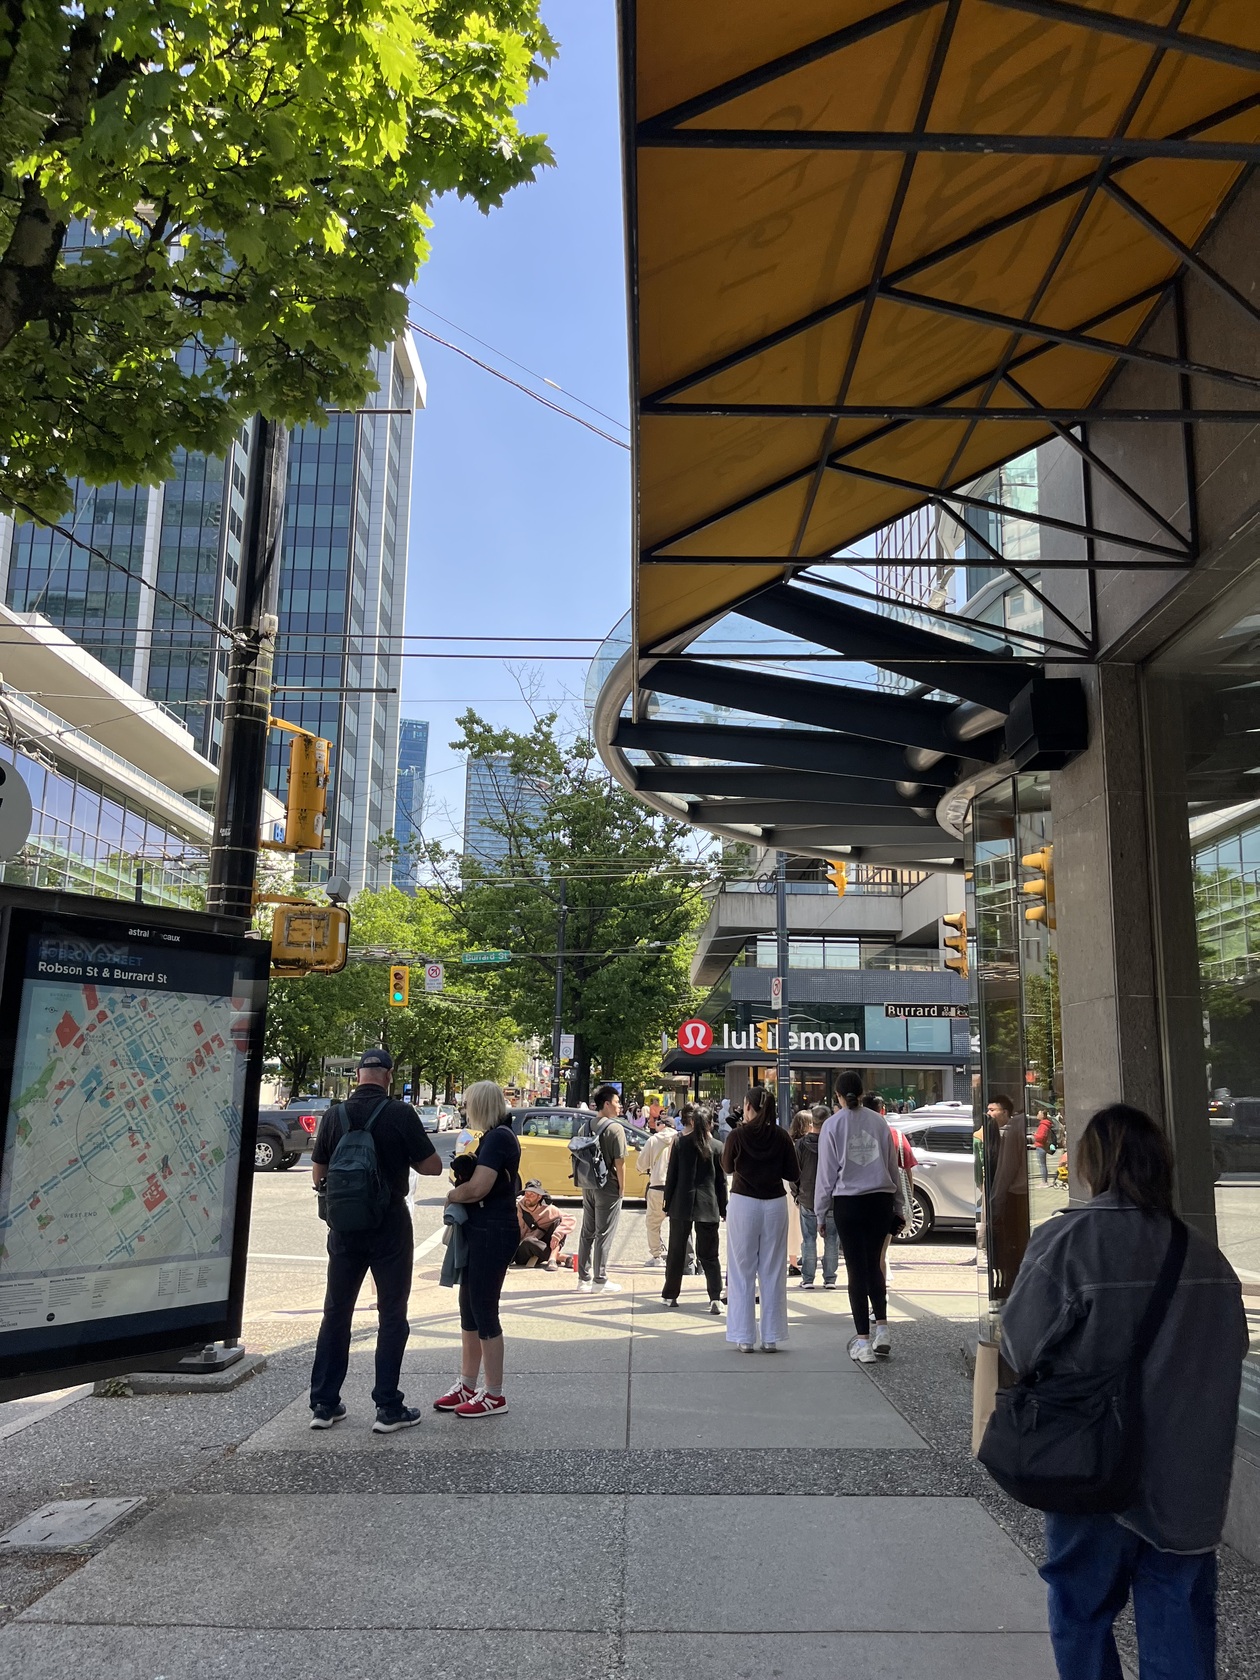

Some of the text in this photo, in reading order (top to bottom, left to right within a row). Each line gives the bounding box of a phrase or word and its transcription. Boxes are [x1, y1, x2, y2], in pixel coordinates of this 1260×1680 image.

[128, 928, 149, 938] astral
[97, 953, 143, 966] STREET
[465, 952, 508, 962] Burrard St
[38, 961, 168, 984] Robson St & Burrard St
[888, 1005, 938, 1017] Burrard
